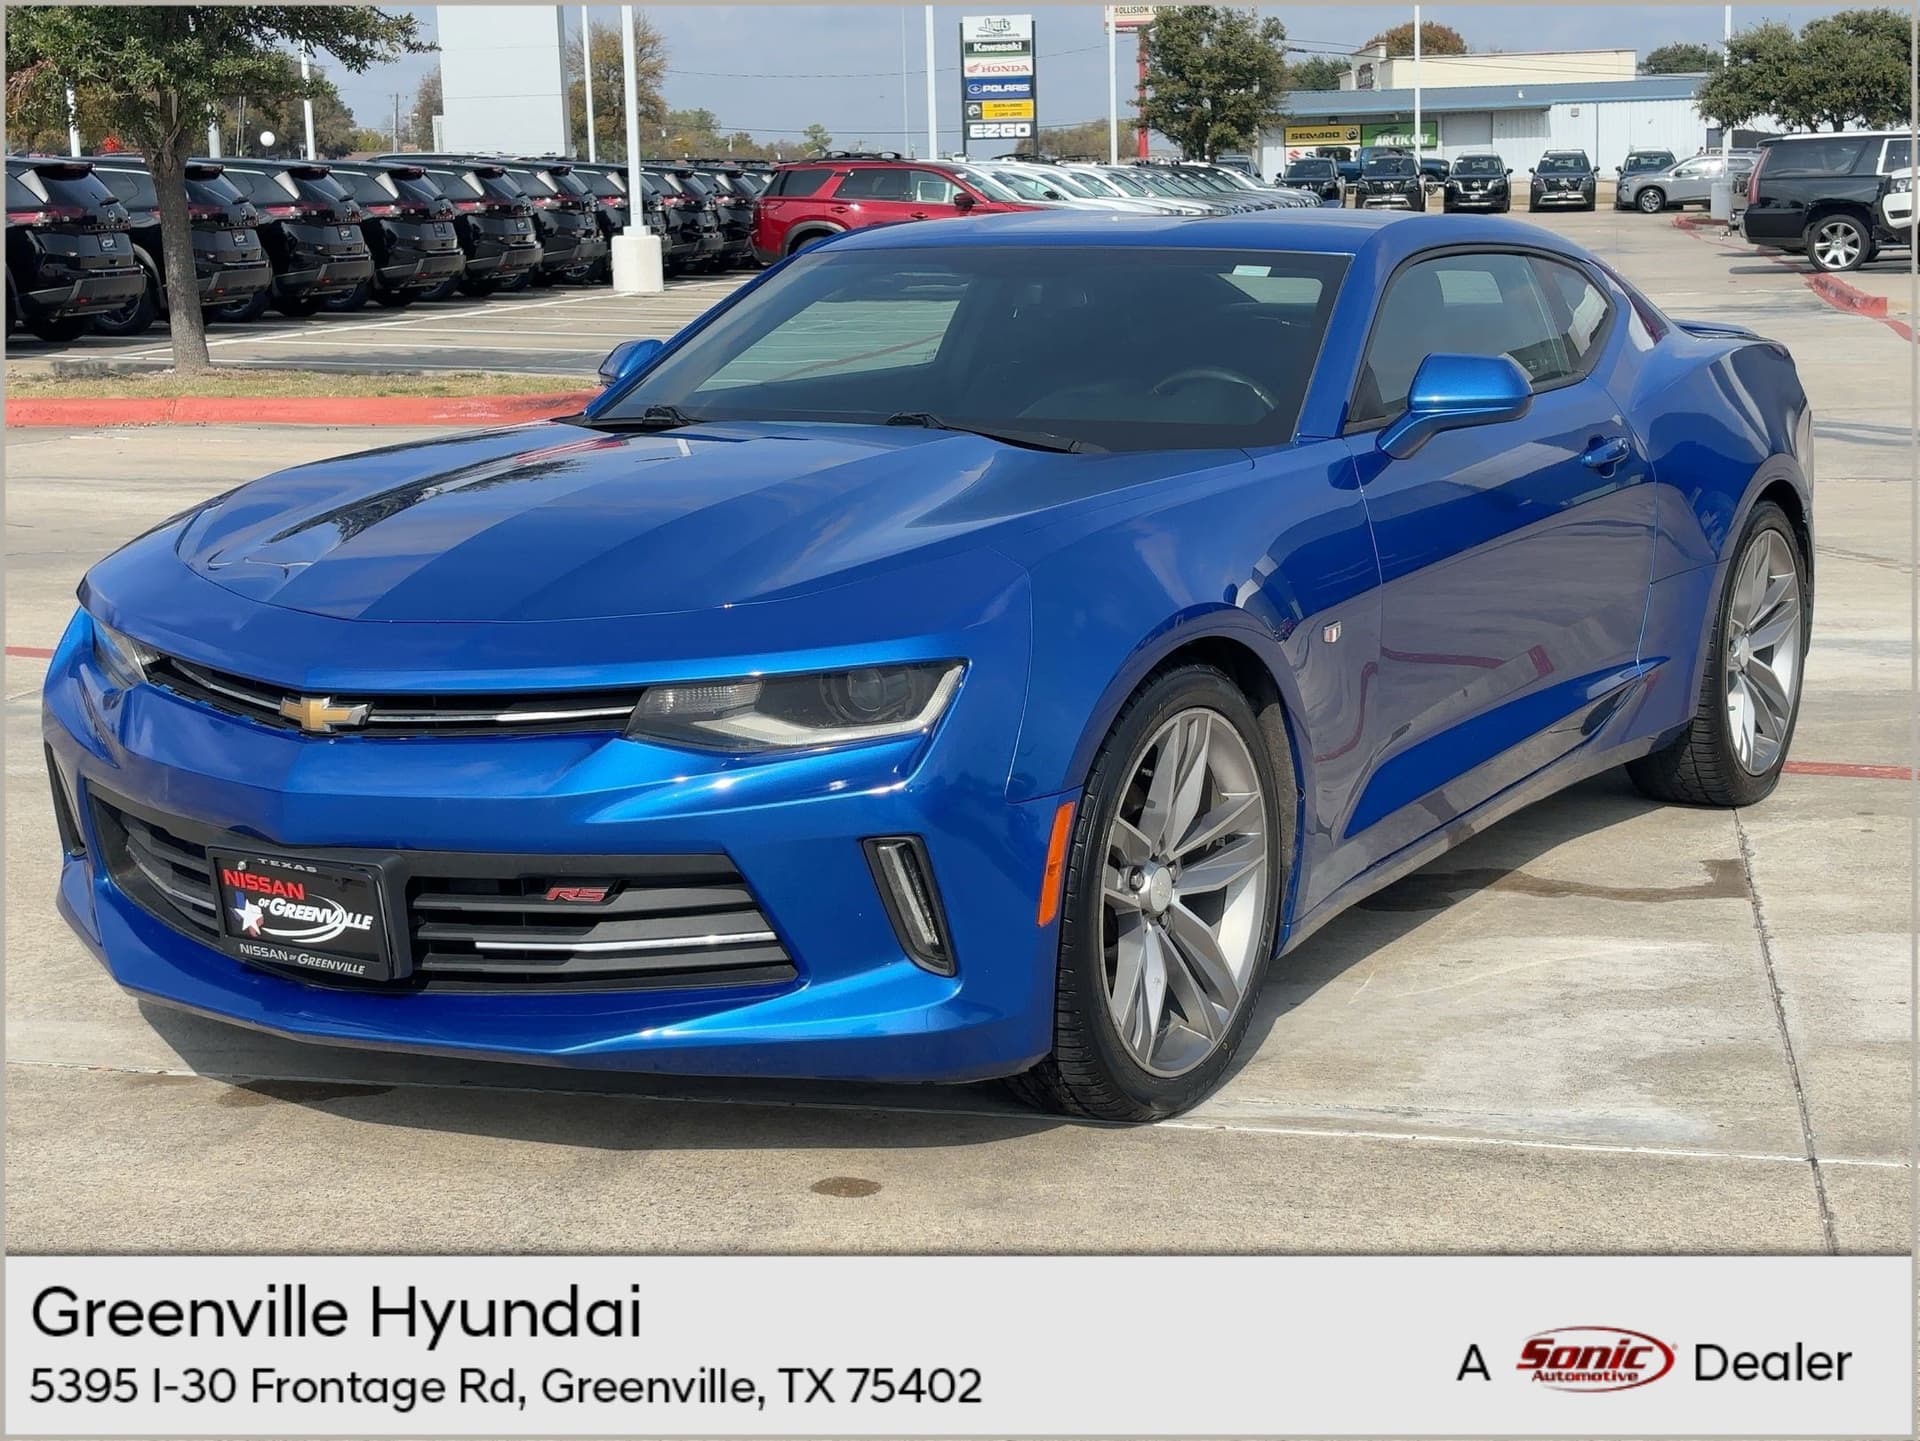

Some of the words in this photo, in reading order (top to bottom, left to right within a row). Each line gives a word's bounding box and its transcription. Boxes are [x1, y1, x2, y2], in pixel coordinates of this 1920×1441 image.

[973, 41, 1022, 52] Kawasaki
[982, 64, 1030, 73] HONDA
[982, 84, 1031, 93] POLARIS
[1375, 134, 1411, 146] ARCTIC
[257, 858, 317, 873] TEXAS
[223, 868, 305, 900] NISSAN
[545, 887, 609, 902] RS
[269, 897, 374, 931] GREENVILLE
[239, 943, 289, 961] NISSAN
[297, 953, 366, 975] GREENVILLE
